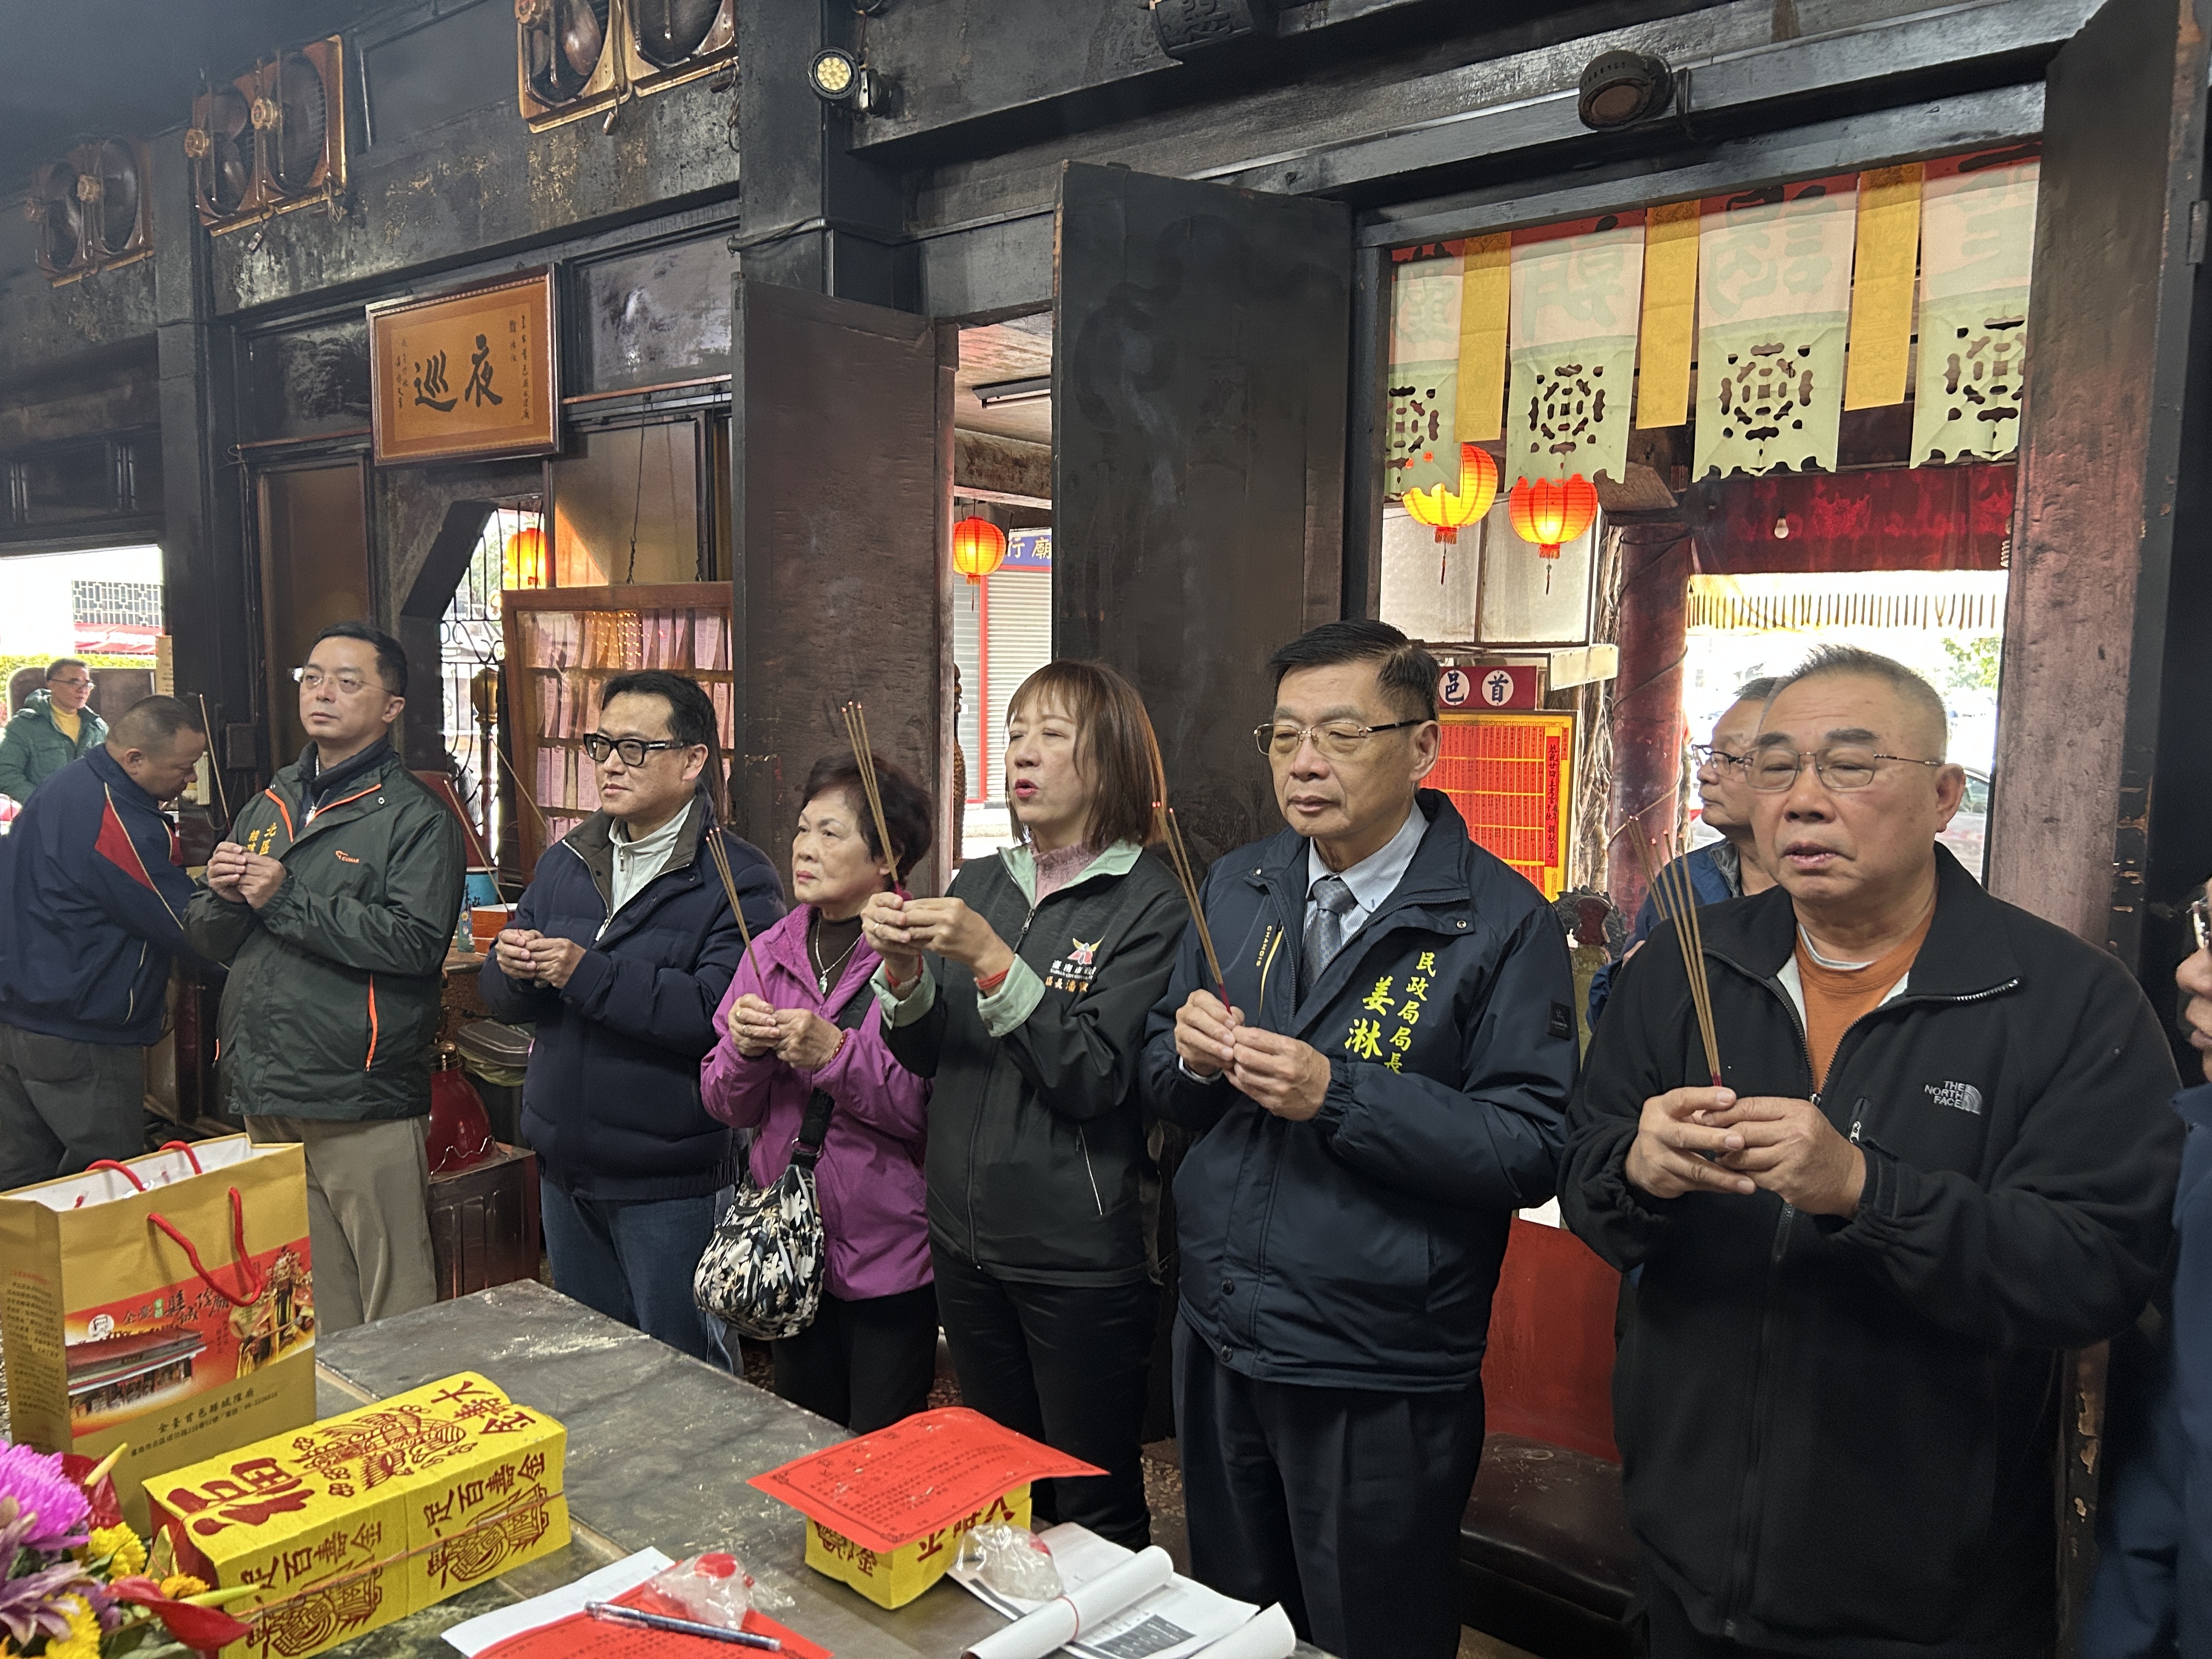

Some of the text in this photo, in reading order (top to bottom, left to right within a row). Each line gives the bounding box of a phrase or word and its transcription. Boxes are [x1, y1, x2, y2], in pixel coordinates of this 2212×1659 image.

[414, 334, 503, 411] 夜巡
[1345, 975, 1395, 1059] 姜淋
[1384, 951, 1436, 1074] 民政局局長
[1925, 1084, 1964, 1100] NORTH
[1934, 1095, 1962, 1108] FACE
[1944, 1080, 1966, 1092] THE
[167, 1457, 315, 1536] 福
